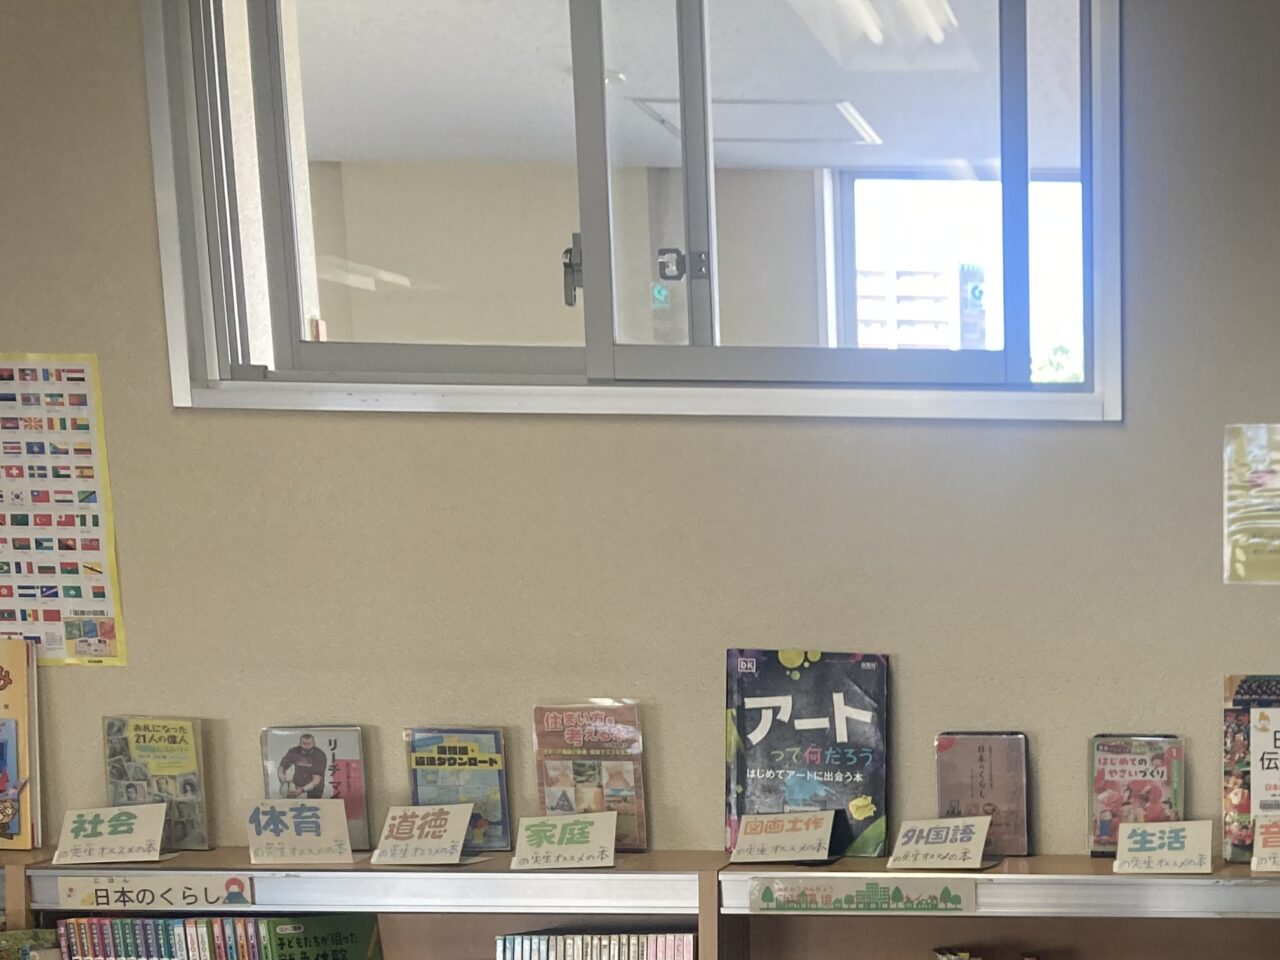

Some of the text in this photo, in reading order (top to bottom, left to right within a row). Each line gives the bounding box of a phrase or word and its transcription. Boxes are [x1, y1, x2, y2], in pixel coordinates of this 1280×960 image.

[740, 660, 754, 670] DK
[133, 723, 188, 733] お札になった
[744, 691, 873, 745] アート
[770, 746, 873, 766] って何だろう
[1098, 757, 1147, 766] はじめての
[746, 768, 864, 782] はじめてアートに出会う本
[1108, 769, 1165, 779] やさいづくり
[70, 811, 137, 839] 社会
[249, 805, 321, 837] 体育
[385, 807, 450, 841] 道徳
[744, 818, 824, 835] 図画工作
[525, 820, 594, 848] 家庭
[901, 824, 976, 846] 外国語
[1127, 827, 1187, 852] 生活
[94, 887, 222, 907] 日本のくらし
